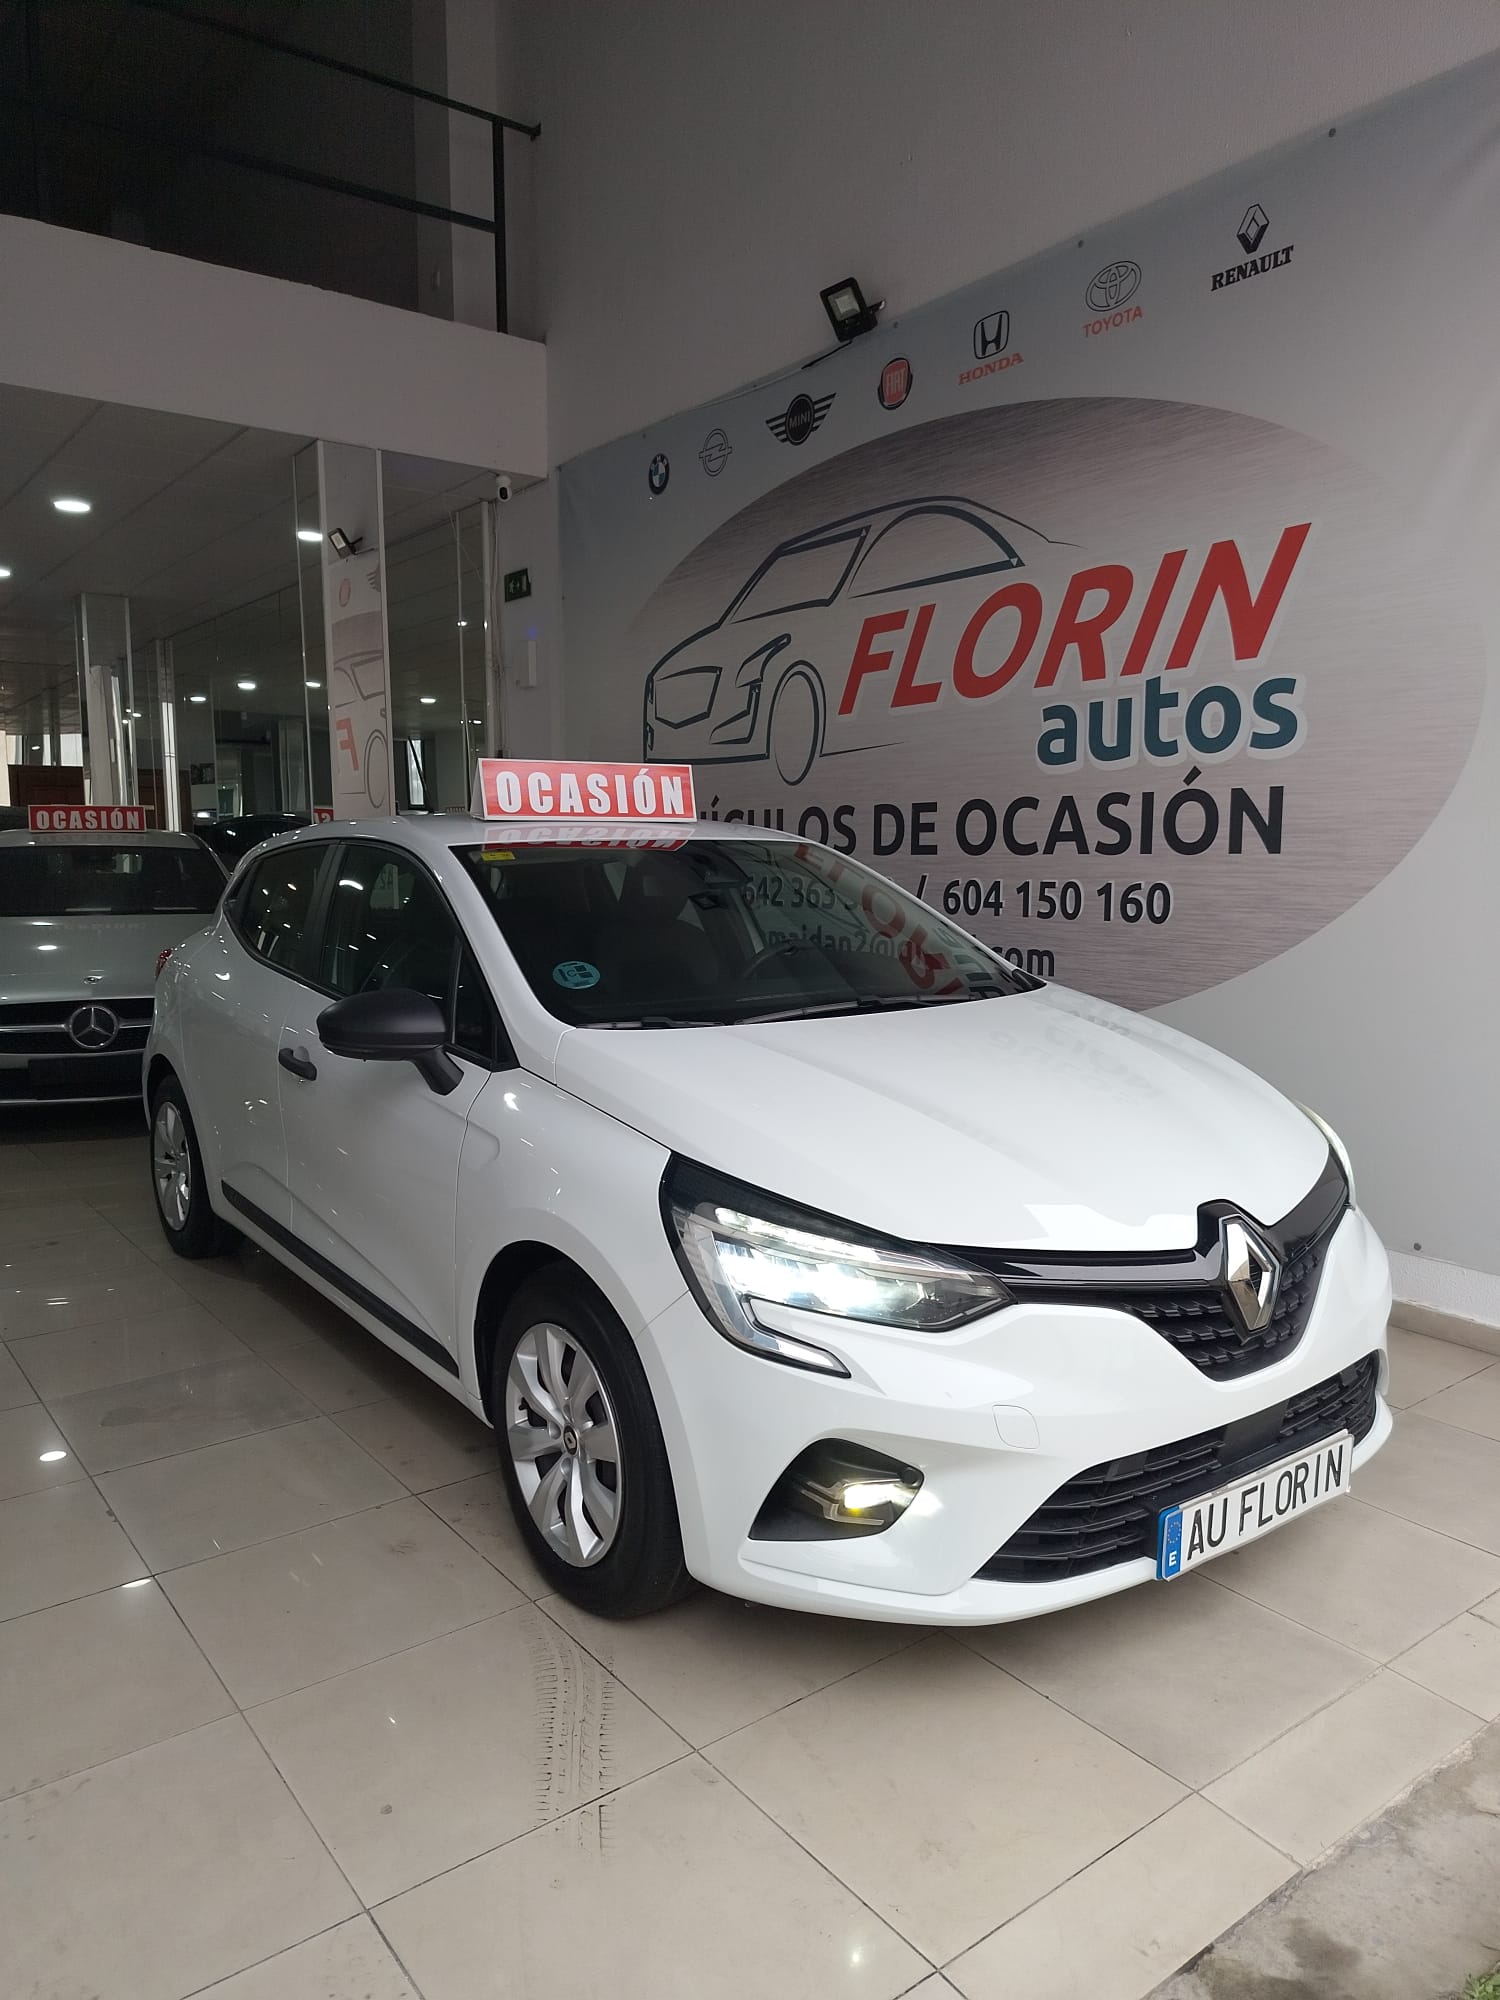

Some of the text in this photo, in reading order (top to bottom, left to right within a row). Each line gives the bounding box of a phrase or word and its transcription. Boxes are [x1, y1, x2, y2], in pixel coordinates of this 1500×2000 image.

[1210, 245, 1294, 292] RENAULT
[1082, 305, 1144, 338] TOYOTA
[958, 352, 1024, 386] HONDA
[788, 413, 812, 430] MINI
[838, 522, 1312, 716] FLORIN
[1036, 675, 1299, 767] autos
[495, 768, 686, 816] OCASIÓN
[873, 801, 938, 857] DE
[955, 765, 1285, 857] OCASIÓN
[35, 807, 140, 830] OCASIÓN
[942, 879, 1003, 917] 604
[1016, 880, 1082, 921] 150
[1096, 881, 1171, 925] 160
[1187, 1444, 1344, 1561] AU FLORIN
[1168, 1550, 1178, 1567] E
